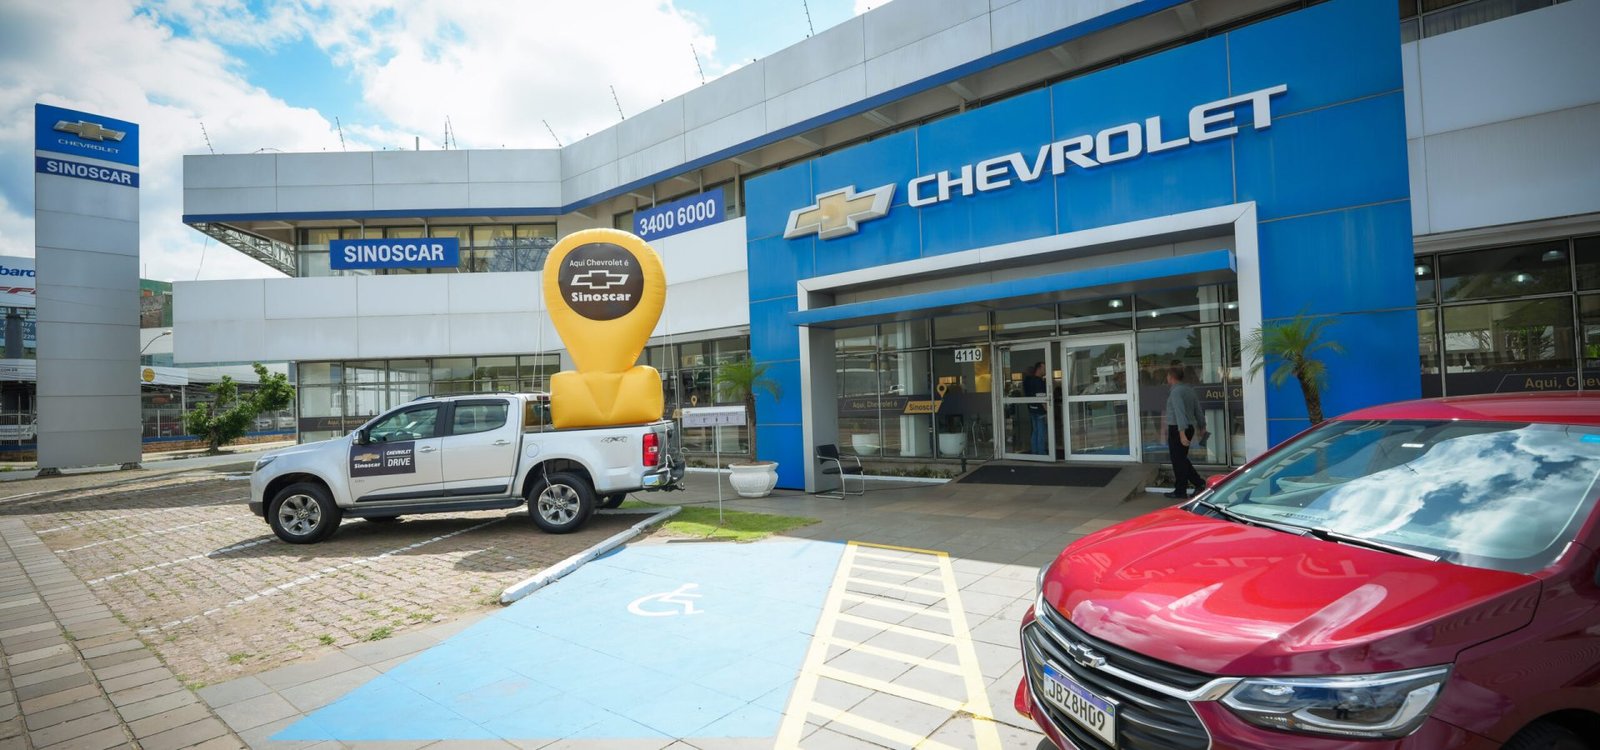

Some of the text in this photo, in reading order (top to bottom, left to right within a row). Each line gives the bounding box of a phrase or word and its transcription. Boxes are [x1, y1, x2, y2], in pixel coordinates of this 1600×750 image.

[57, 138, 120, 154] CHEVROLET
[908, 84, 1288, 208] CHEVROLET
[46, 160, 132, 185] SINOSCAR
[639, 198, 716, 236] 3400 6000
[343, 244, 445, 263] SINOSCAR
[569, 259, 585, 268] Aqui
[586, 258, 623, 267] Chevrolet
[571, 292, 632, 302] Sinoscar
[955, 349, 981, 362] 4119
[387, 457, 411, 467] DRIVE
